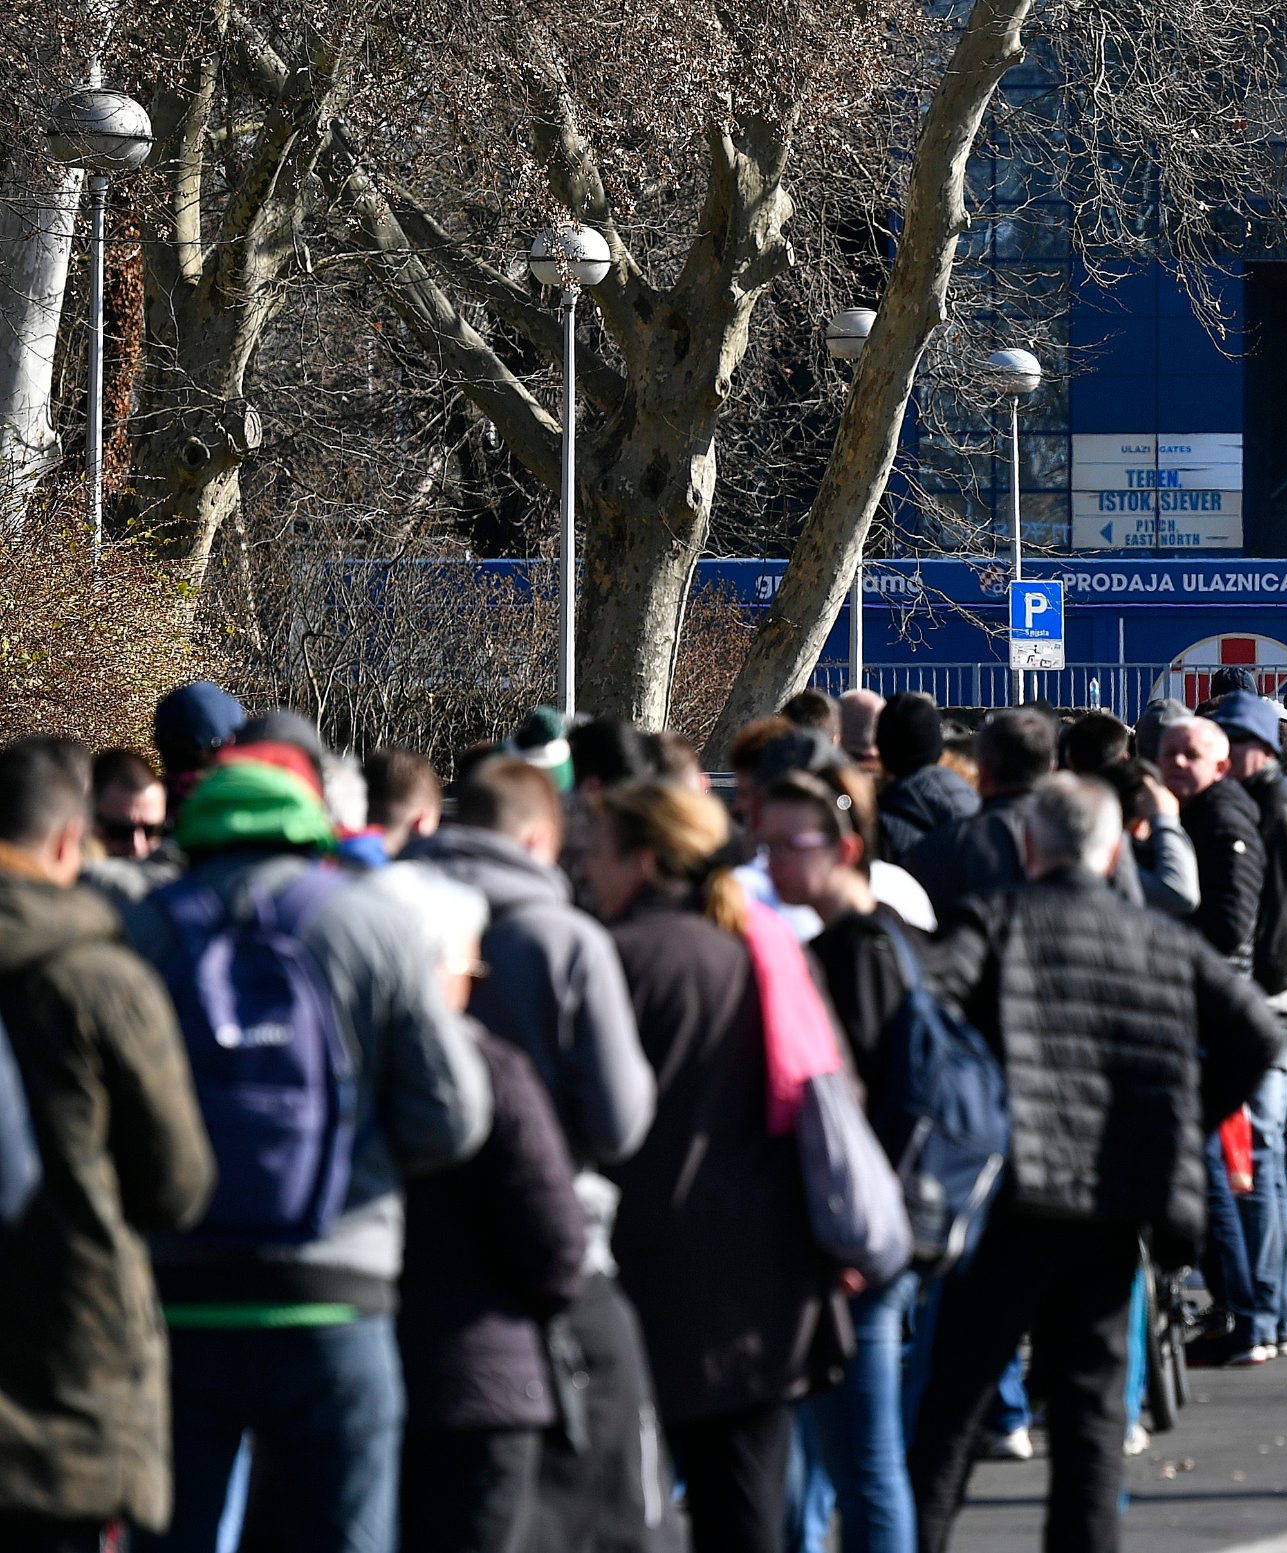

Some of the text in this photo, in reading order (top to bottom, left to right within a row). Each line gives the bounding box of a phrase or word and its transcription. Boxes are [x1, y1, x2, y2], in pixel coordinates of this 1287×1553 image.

[1121, 445, 1192, 454] ULAZI GATES
[1125, 469, 1182, 489] TEREN,
[1161, 491, 1222, 512] SJEVER
[1160, 534, 1200, 546] NORTH
[1062, 573, 1175, 592] PRODAJA
[1024, 592, 1048, 629] P
